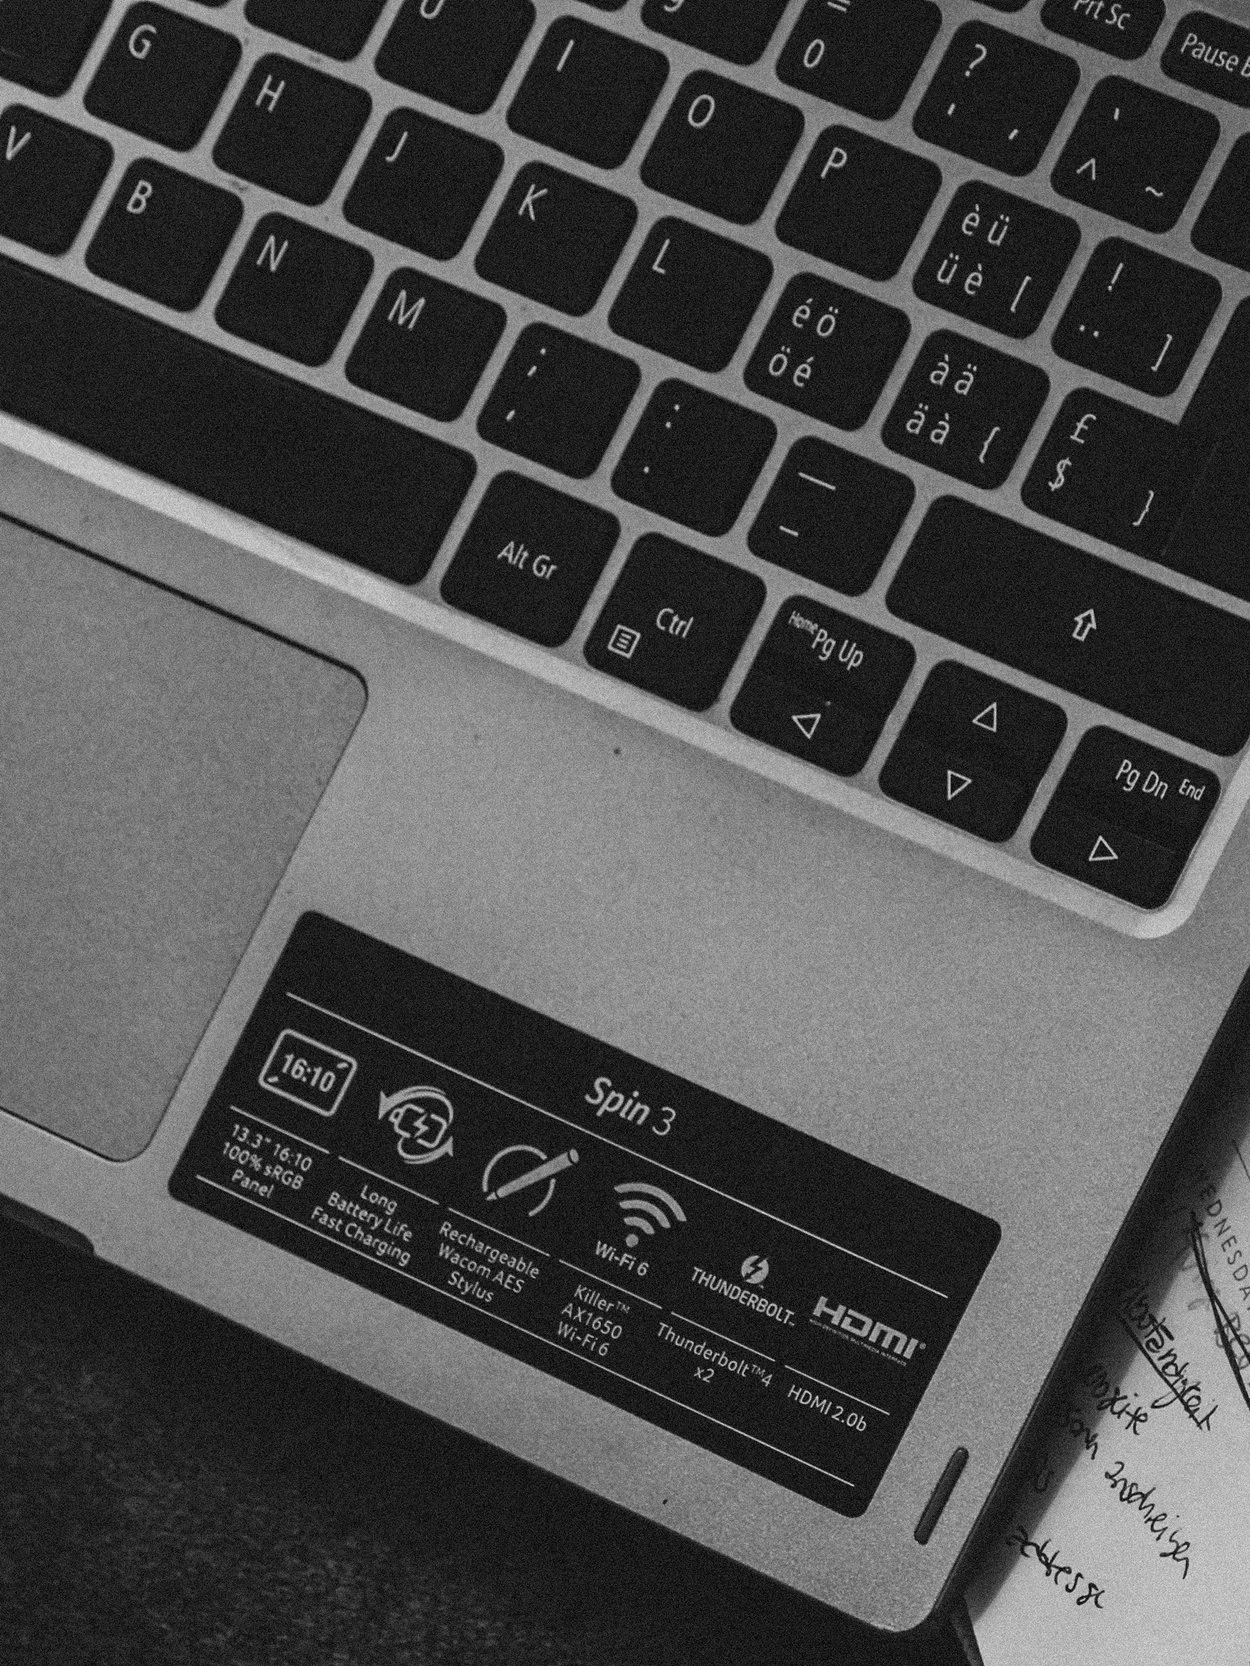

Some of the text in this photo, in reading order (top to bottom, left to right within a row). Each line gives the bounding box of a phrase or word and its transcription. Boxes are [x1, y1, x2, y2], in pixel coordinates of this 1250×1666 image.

[1102, 0, 1130, 29] Sc
[128, 24, 156, 59] G
[557, 40, 574, 71] I
[803, 39, 825, 68] 0
[1181, 33, 1239, 71] Pause
[965, 44, 987, 77] ?
[256, 75, 285, 111] H
[687, 94, 715, 128] O
[5, 126, 31, 160] V
[386, 132, 408, 162] J
[821, 147, 847, 178] P
[126, 180, 153, 214] B
[518, 184, 547, 220] K
[257, 235, 288, 272] N
[652, 239, 670, 274] L
[388, 290, 425, 329] M
[1070, 413, 1096, 444] £
[1048, 458, 1071, 491] $
[497, 541, 557, 578] Alt Gr
[656, 608, 694, 638] Ctrl
[789, 612, 863, 670] Home Pg Up
[1116, 759, 1205, 800] Pg Dn End
[282, 1054, 336, 1092] 16:10
[585, 1077, 676, 1136] Spin 3
[223, 1142, 303, 1189] 100% sRGB
[274, 1144, 312, 1171] 16:10
[232, 1169, 274, 1197] Panel
[361, 1185, 397, 1215] Long
[328, 1192, 412, 1241] Battery Life
[312, 1206, 410, 1266] Fast Charging
[440, 1222, 539, 1278] Rechargeable
[439, 1244, 524, 1293] Wacom AES
[595, 1241, 649, 1276] Wi-Fi 6
[448, 1271, 492, 1302] Stylus
[692, 1267, 794, 1323] THUNDERBOLT
[562, 1304, 622, 1339] AX1650
[813, 1296, 918, 1359] HDMI
[558, 1323, 608, 1356] Wi-Fi 6
[695, 1368, 714, 1382] x2
[788, 1385, 866, 1431] HDMI 2.0b
